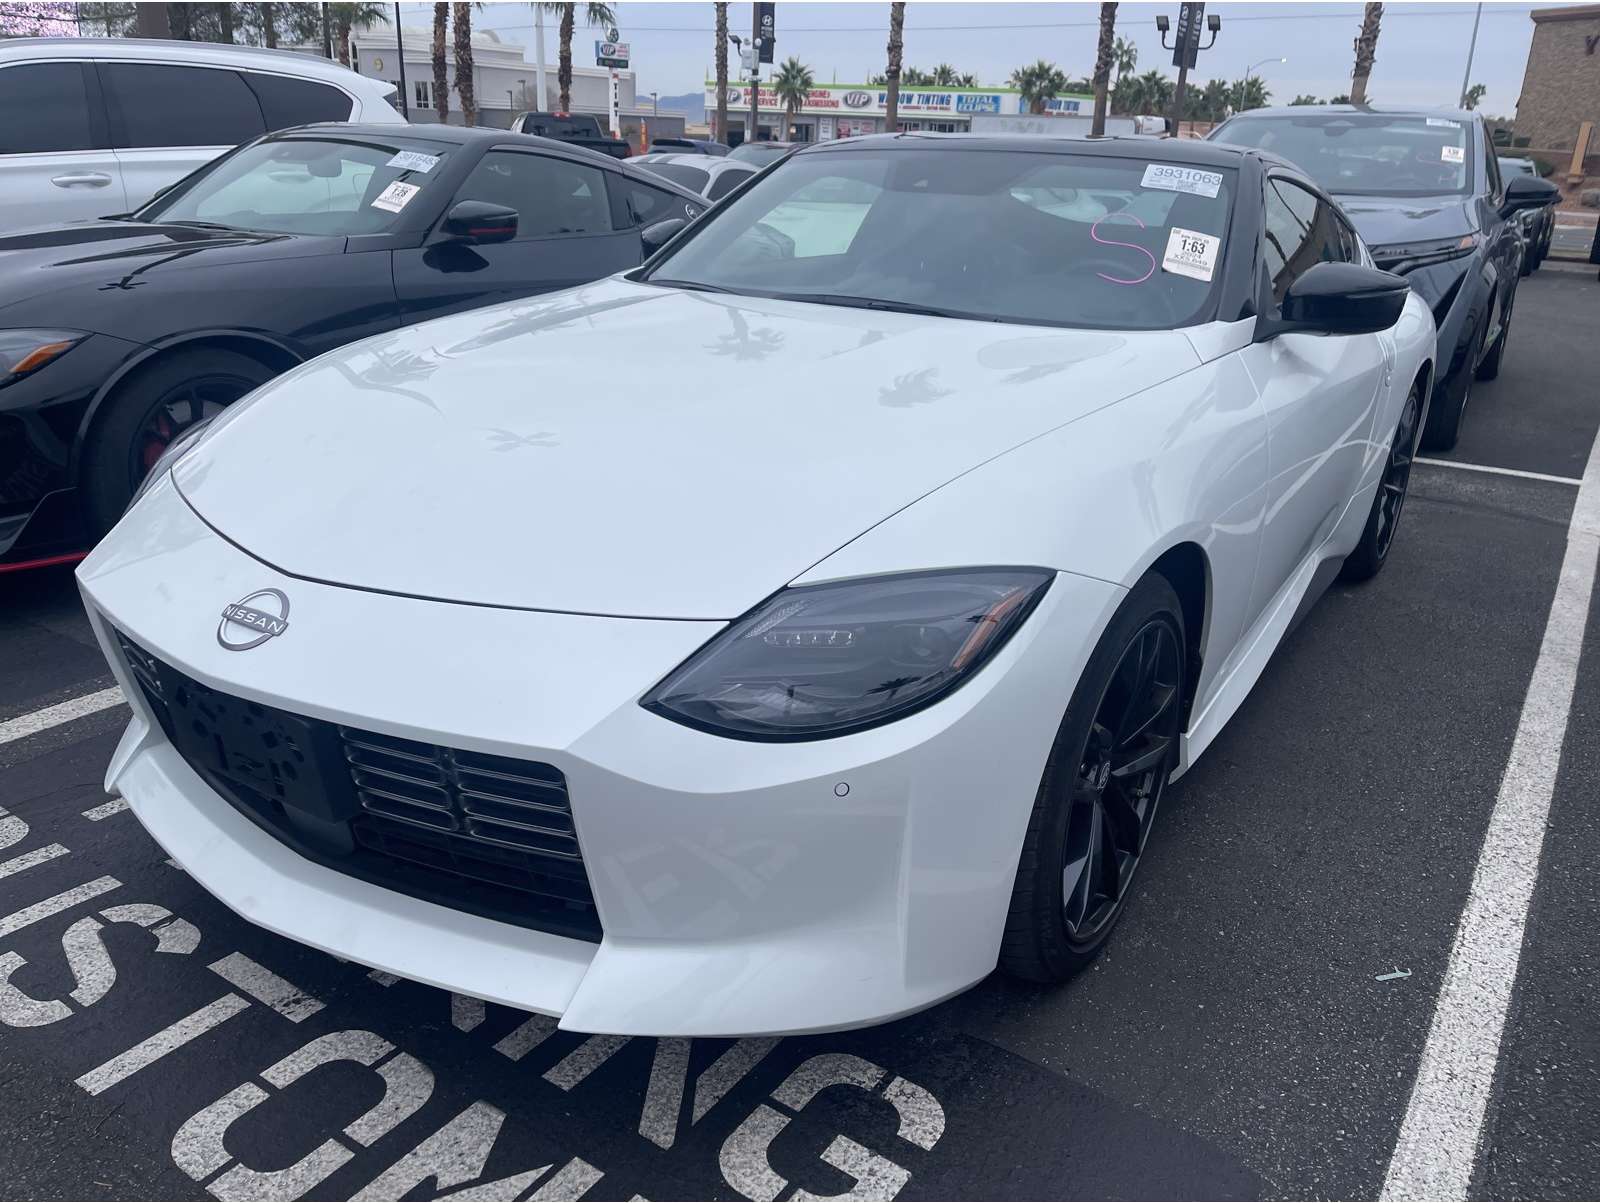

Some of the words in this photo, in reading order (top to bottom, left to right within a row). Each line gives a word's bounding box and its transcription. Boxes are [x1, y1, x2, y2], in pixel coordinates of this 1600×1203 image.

[847, 93, 868, 105] VIP
[879, 93, 914, 105] WIOW
[917, 94, 951, 106] TINTING
[962, 96, 993, 104] TOTAL
[1153, 167, 1221, 185] 3931063
[1181, 238, 1206, 255] 1:63
[223, 605, 284, 633] NISSAN
